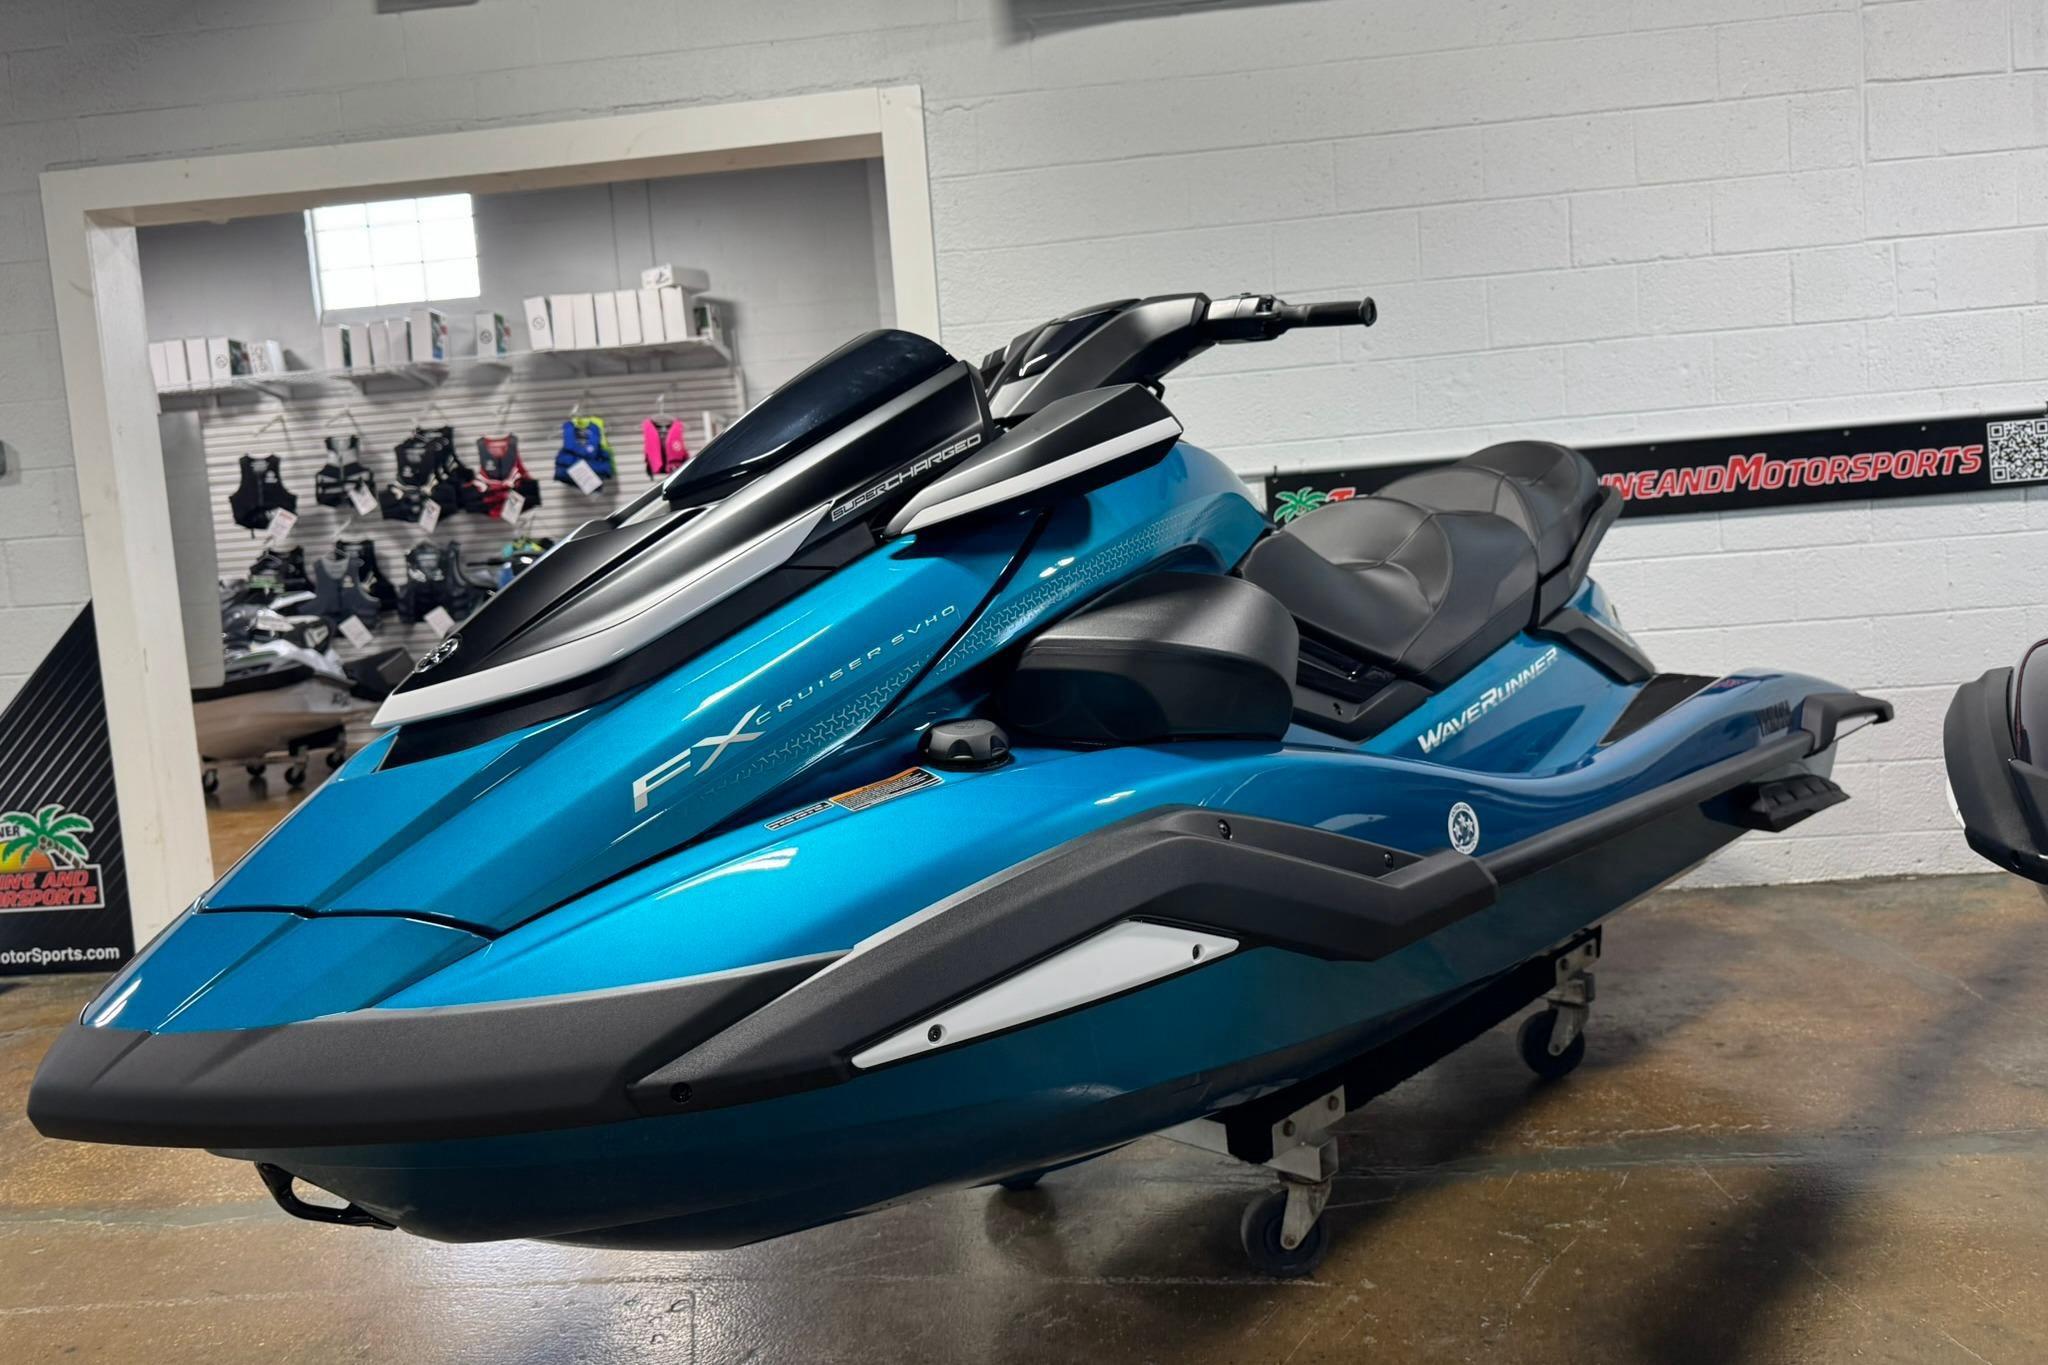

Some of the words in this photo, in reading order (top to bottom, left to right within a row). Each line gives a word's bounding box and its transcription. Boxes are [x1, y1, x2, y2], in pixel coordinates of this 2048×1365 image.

[832, 433, 981, 522] SUPERCHARGED
[632, 704, 766, 813] FX
[756, 647, 881, 726] CRUISER
[891, 605, 955, 647] SVHO
[41, 869, 89, 889] AND
[1, 947, 120, 966] otorSports.com
